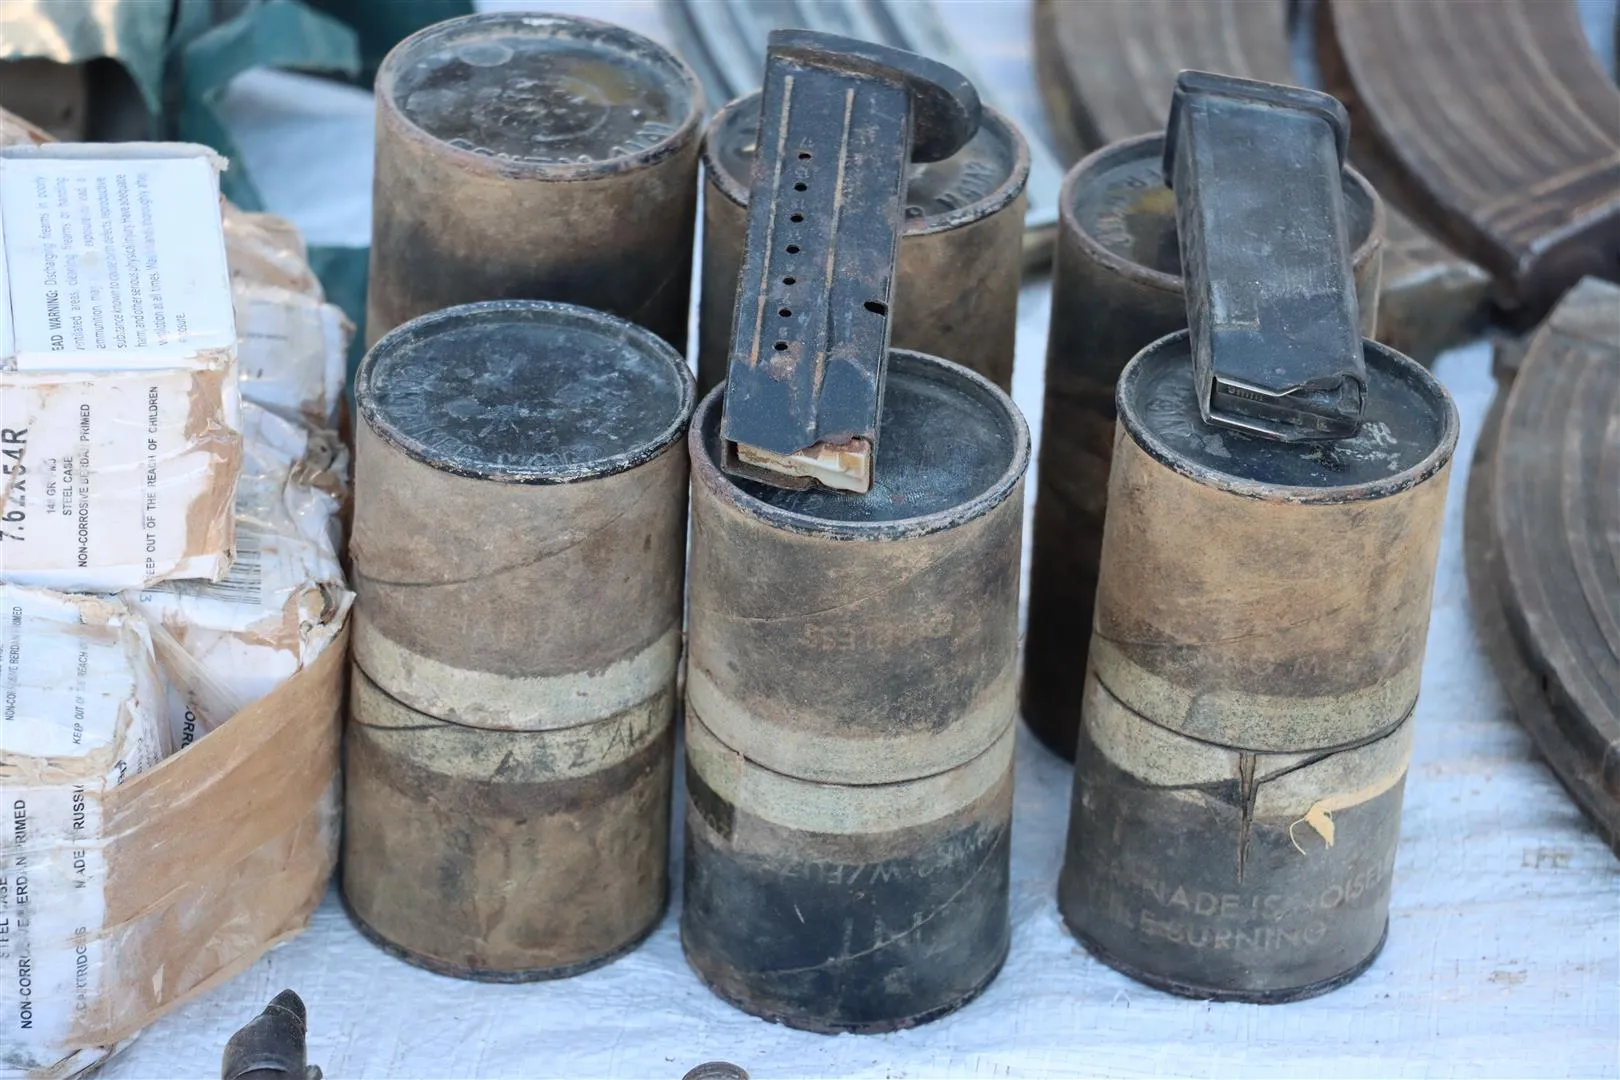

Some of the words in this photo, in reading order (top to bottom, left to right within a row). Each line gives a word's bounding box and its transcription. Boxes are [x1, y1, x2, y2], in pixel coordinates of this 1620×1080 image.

[45, 290, 61, 330] WARNING:
[51, 334, 64, 351] EAD
[148, 386, 158, 433] CHILDREN
[80, 404, 90, 442] PRIMED
[148, 438, 157, 450] OF
[63, 457, 73, 482] CASE
[147, 455, 157, 487] REACH
[46, 500, 56, 514] 14
[62, 486, 73, 516] STEEL
[146, 493, 157, 510] THE
[78, 488, 89, 567] NON-CORROSIVE
[146, 516, 156, 528] OF
[146, 534, 156, 552] OUT
[146, 557, 156, 576] EEP
[74, 706, 84, 719] OUT
[72, 723, 83, 744] KEEP
